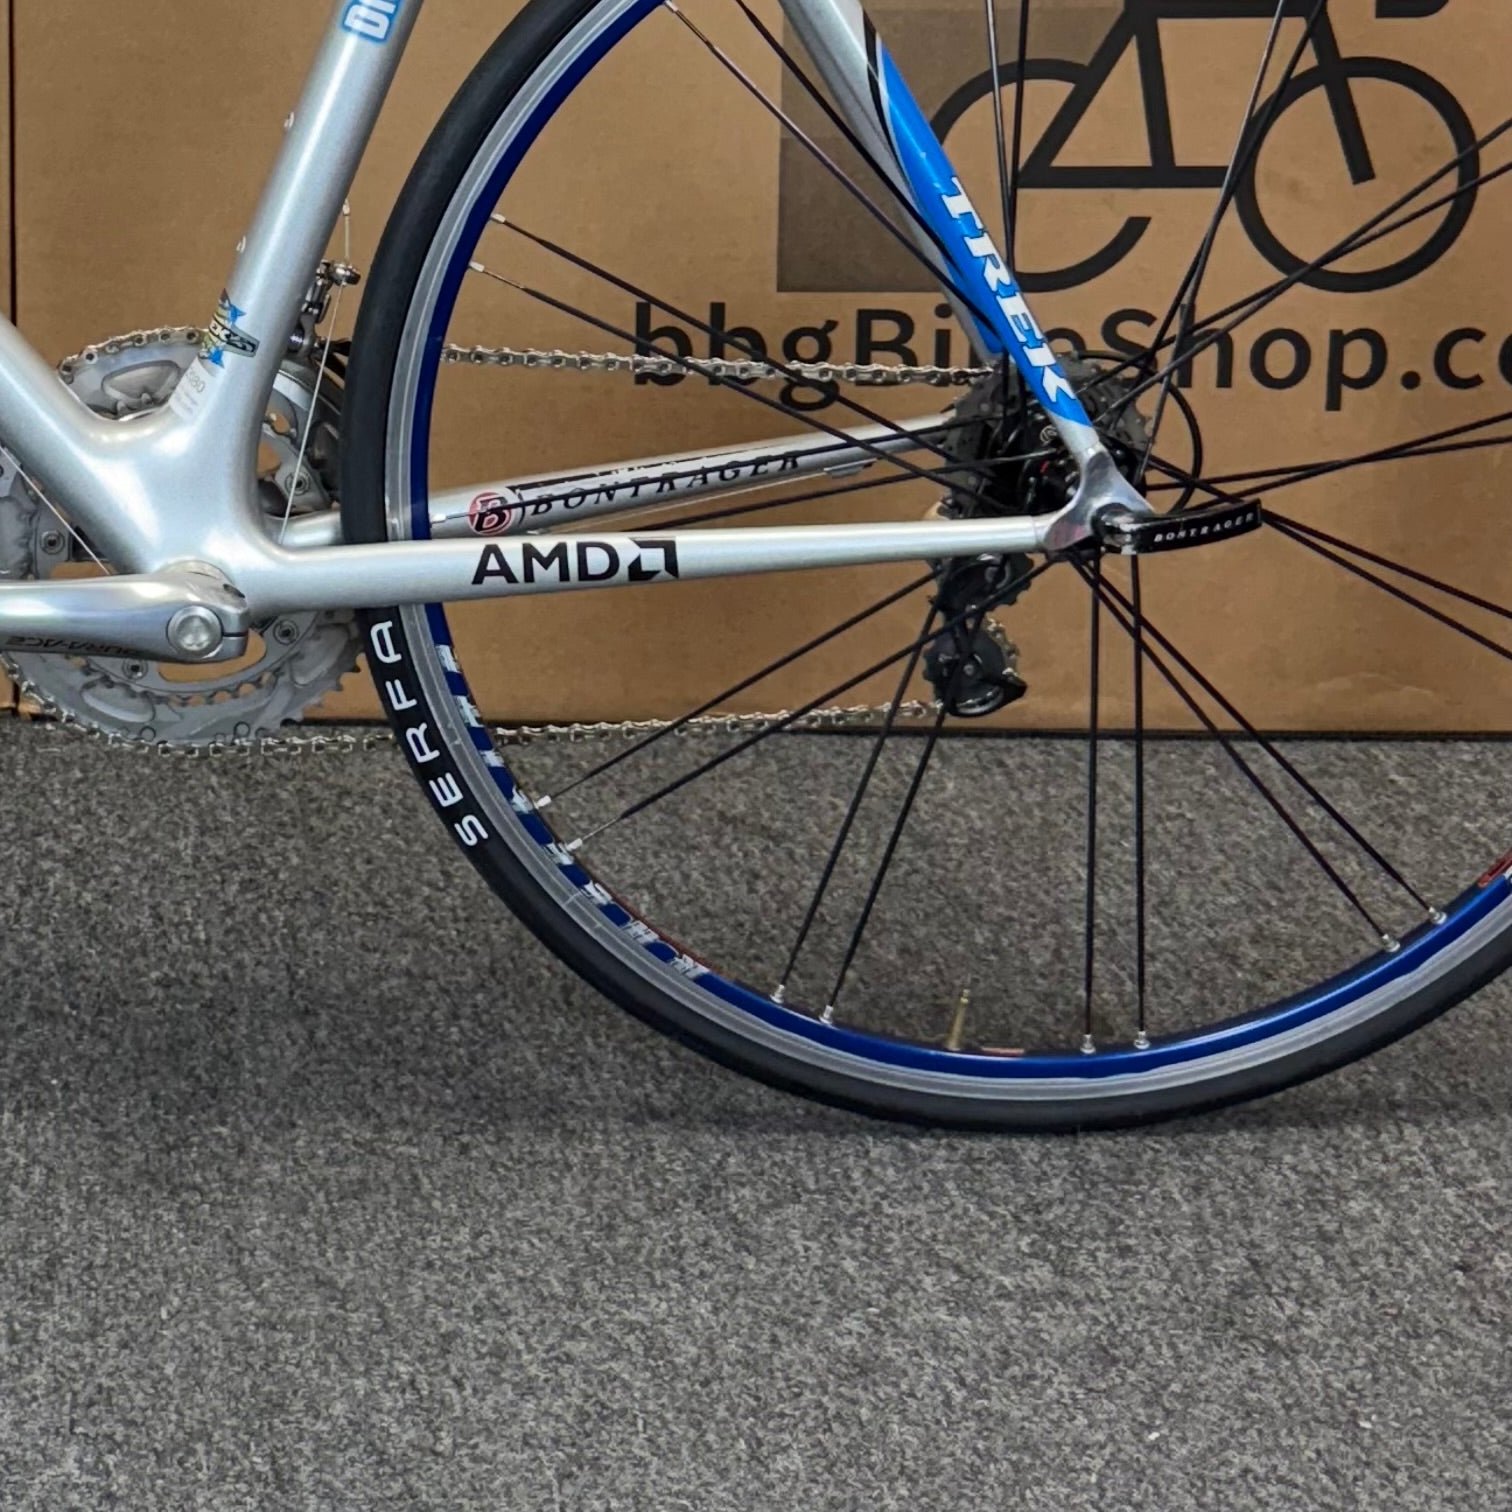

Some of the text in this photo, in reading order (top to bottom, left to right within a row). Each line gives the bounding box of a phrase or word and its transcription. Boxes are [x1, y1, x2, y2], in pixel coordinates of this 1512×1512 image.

[940, 176, 1077, 403] TREK
[531, 451, 802, 517] BONTRAGER
[1153, 511, 1255, 544] BONTRAGER
[471, 541, 620, 585] AMD
[370, 620, 489, 847] SERFA
